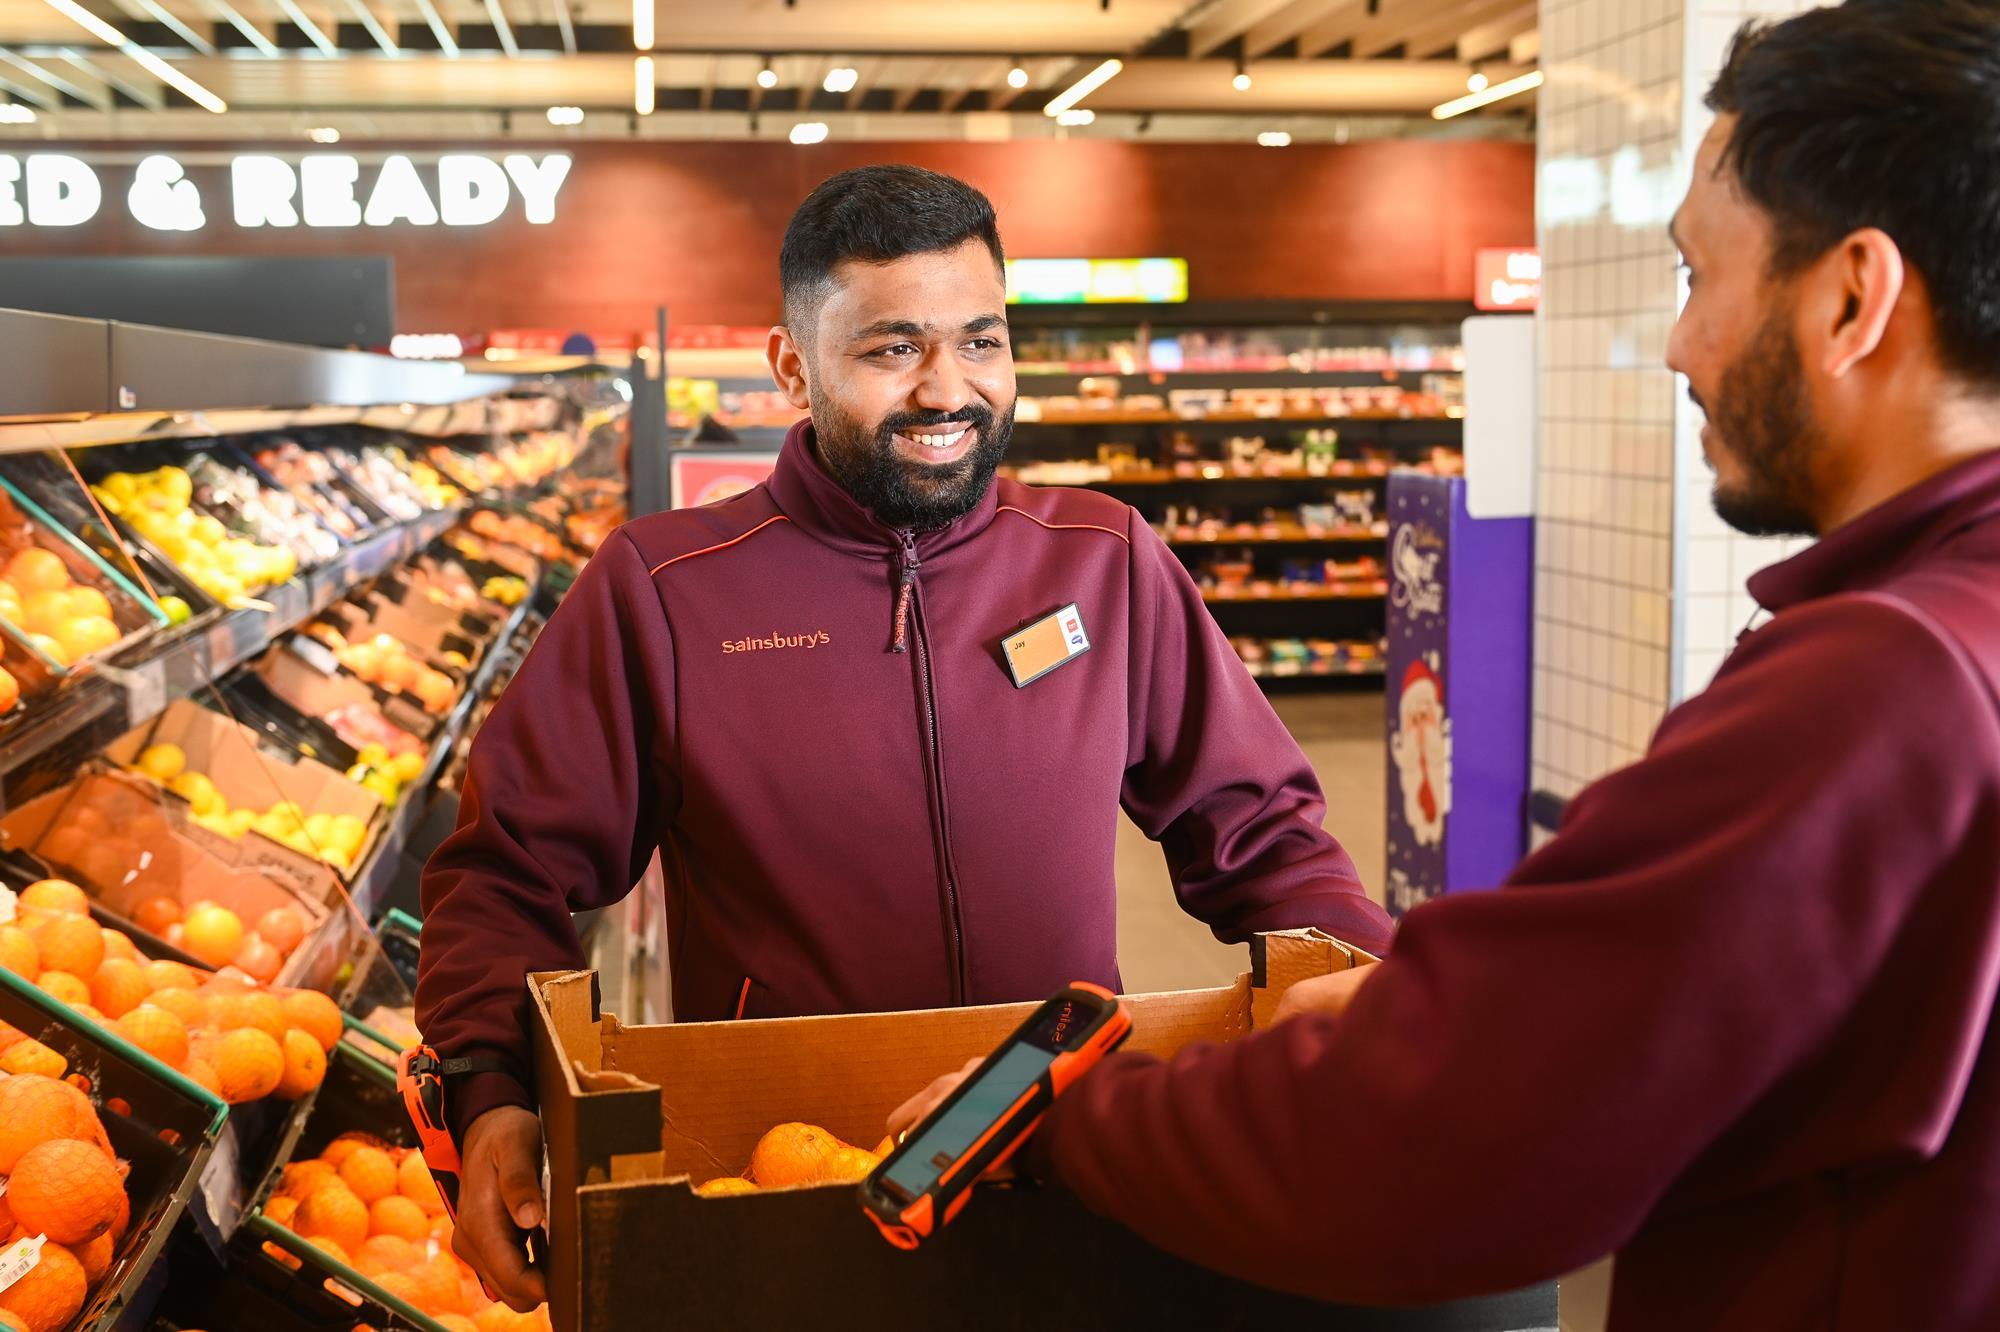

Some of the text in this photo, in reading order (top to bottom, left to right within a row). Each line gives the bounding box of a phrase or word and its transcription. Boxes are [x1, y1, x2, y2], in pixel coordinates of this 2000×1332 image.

[128, 155, 206, 231] &
[231, 154, 572, 227] READY
[721, 630, 831, 654] Sainsbury's
[1014, 640, 1026, 650] Jay
